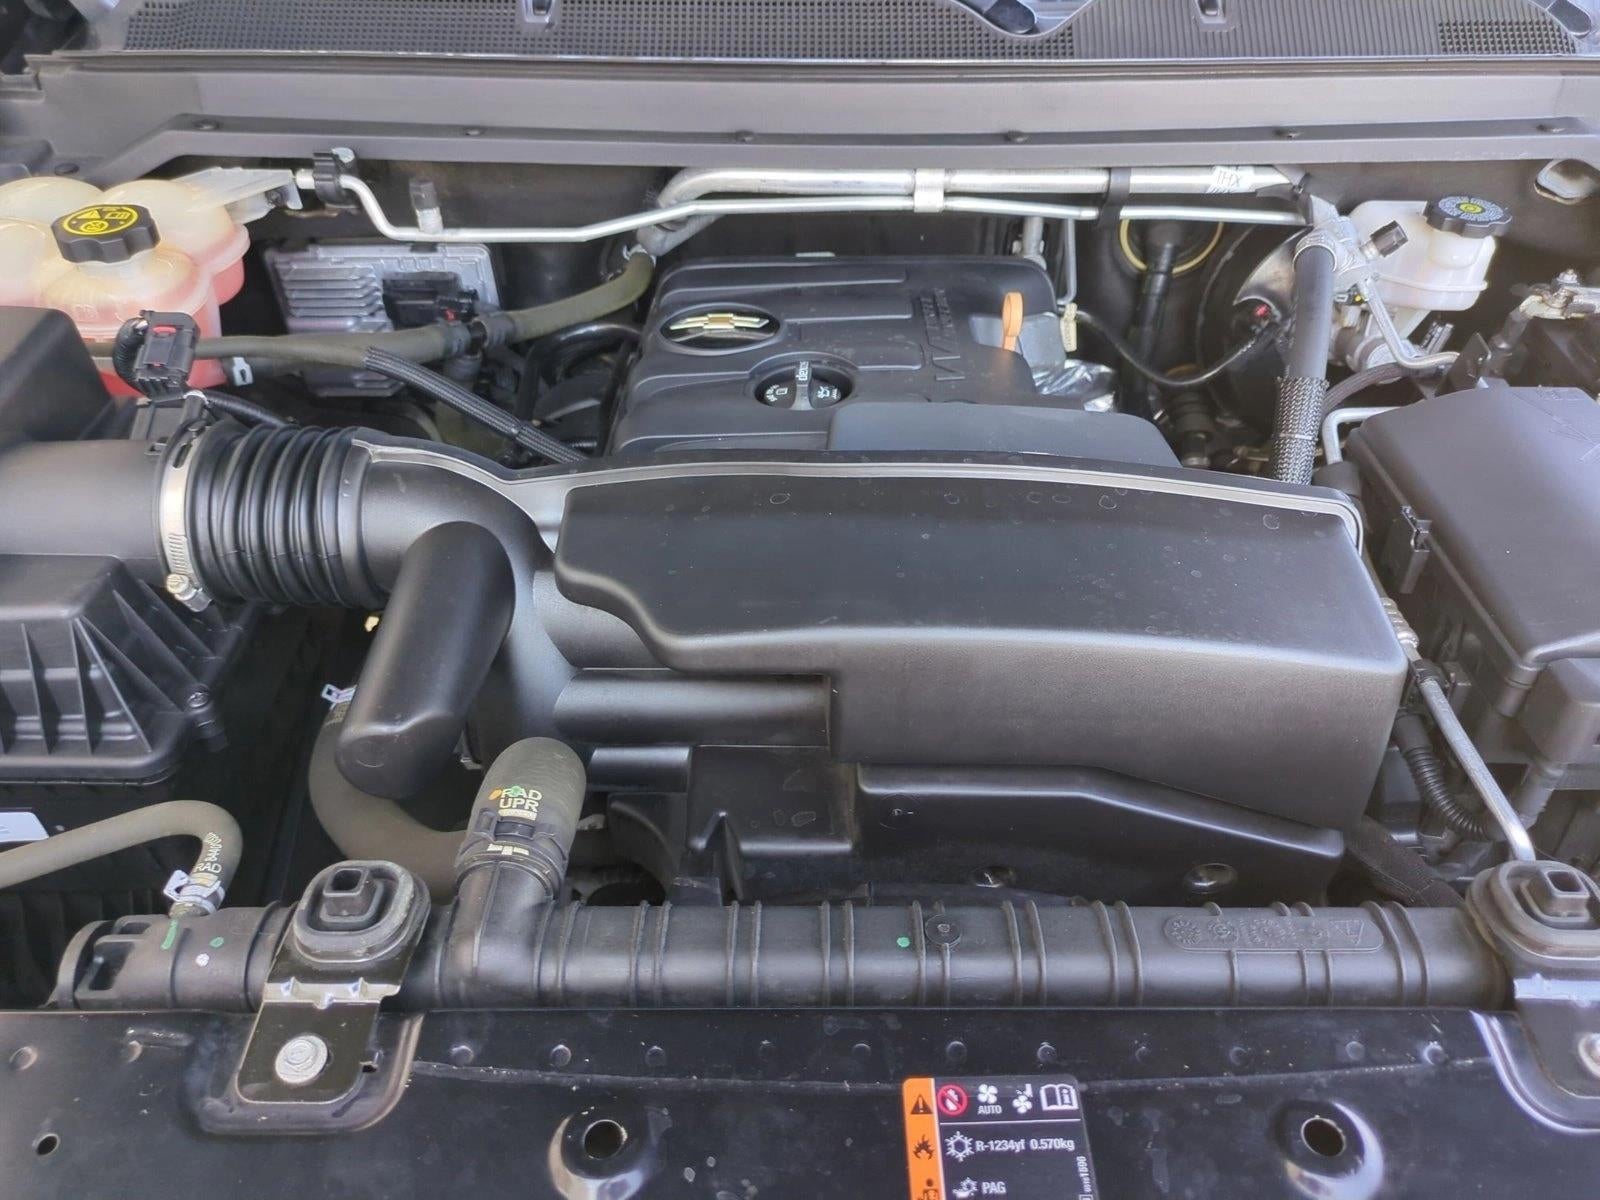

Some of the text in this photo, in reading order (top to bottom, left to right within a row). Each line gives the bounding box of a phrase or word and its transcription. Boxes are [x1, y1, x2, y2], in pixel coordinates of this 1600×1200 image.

[499, 798, 539, 813] UPR
[193, 862, 223, 874] RAD
[977, 1104, 1003, 1115] AUTO
[975, 1138, 1075, 1153] R-1234yf 0.570kg
[982, 1181, 1007, 1195] PAG
